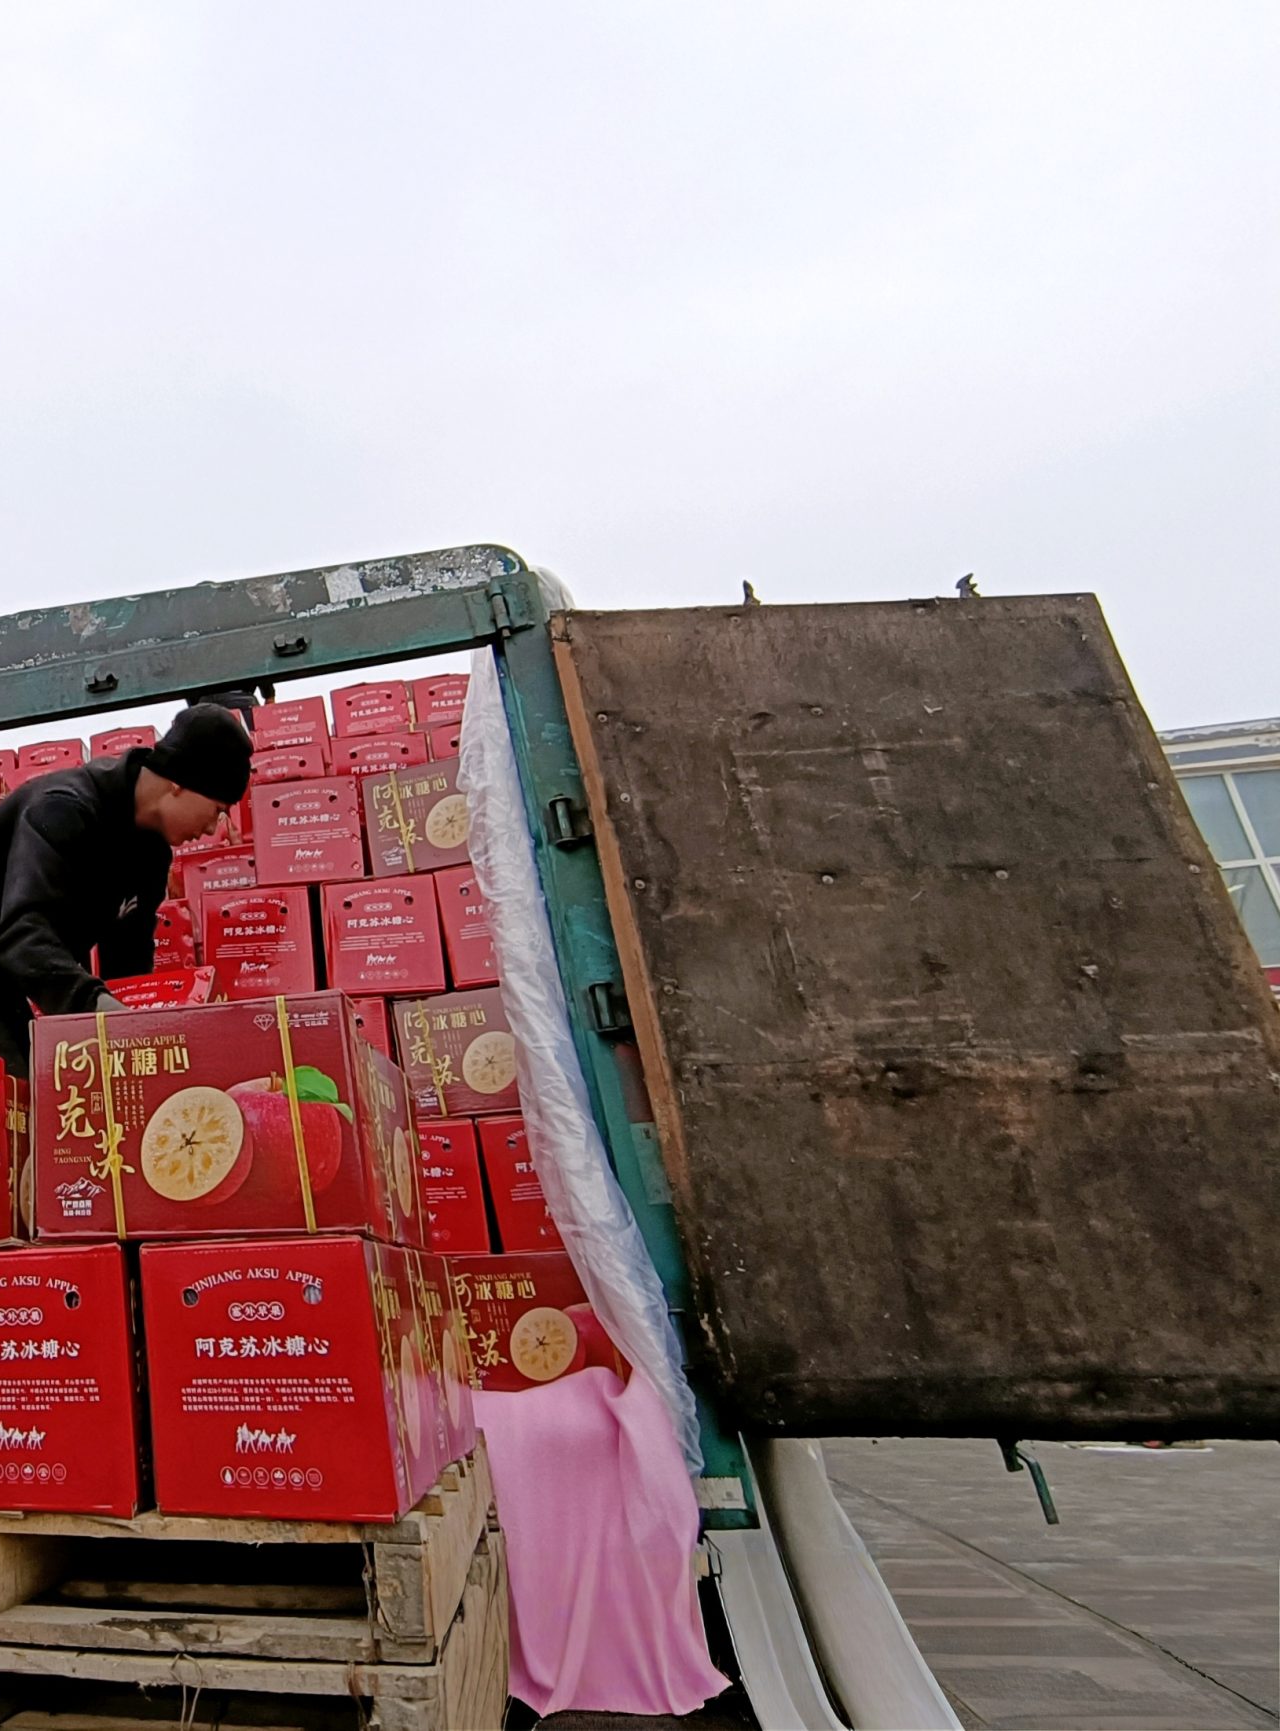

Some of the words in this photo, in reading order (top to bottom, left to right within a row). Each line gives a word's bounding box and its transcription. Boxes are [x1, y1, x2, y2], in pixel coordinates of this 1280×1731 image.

[432, 1009, 487, 1032] 冰糖心
[153, 1033, 187, 1046] APPLE
[106, 1045, 190, 1078] 冰糖心
[11, 1275, 41, 1287] AKSU
[247, 1268, 280, 1280] AKSU
[285, 1270, 324, 1289] APPLE
[474, 1280, 537, 1301] 冰糖心
[195, 1336, 330, 1359] 阿克苏冰糖心
